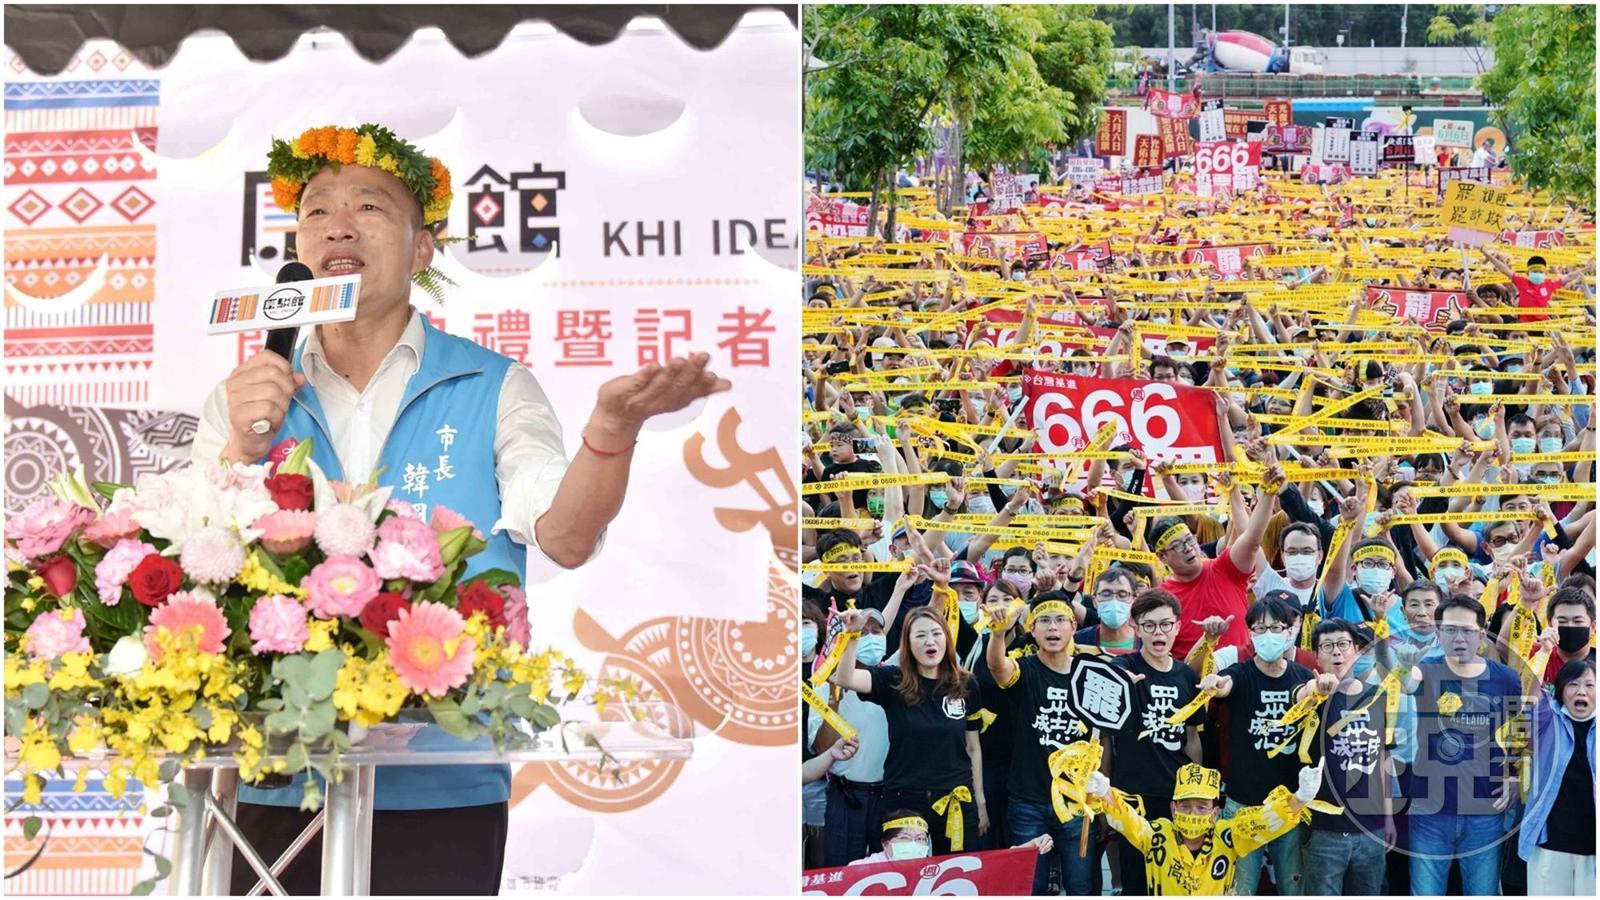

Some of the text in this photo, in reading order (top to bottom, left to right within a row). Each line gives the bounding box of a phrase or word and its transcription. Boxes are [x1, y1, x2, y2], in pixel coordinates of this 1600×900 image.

[1112, 112, 1122, 150] 六月六日
[1195, 142, 1249, 174] 666
[603, 220, 682, 257] KHI
[1033, 377, 1077, 390] 台灣基進
[433, 424, 458, 481] 市長
[1082, 668, 1123, 723] 罷
